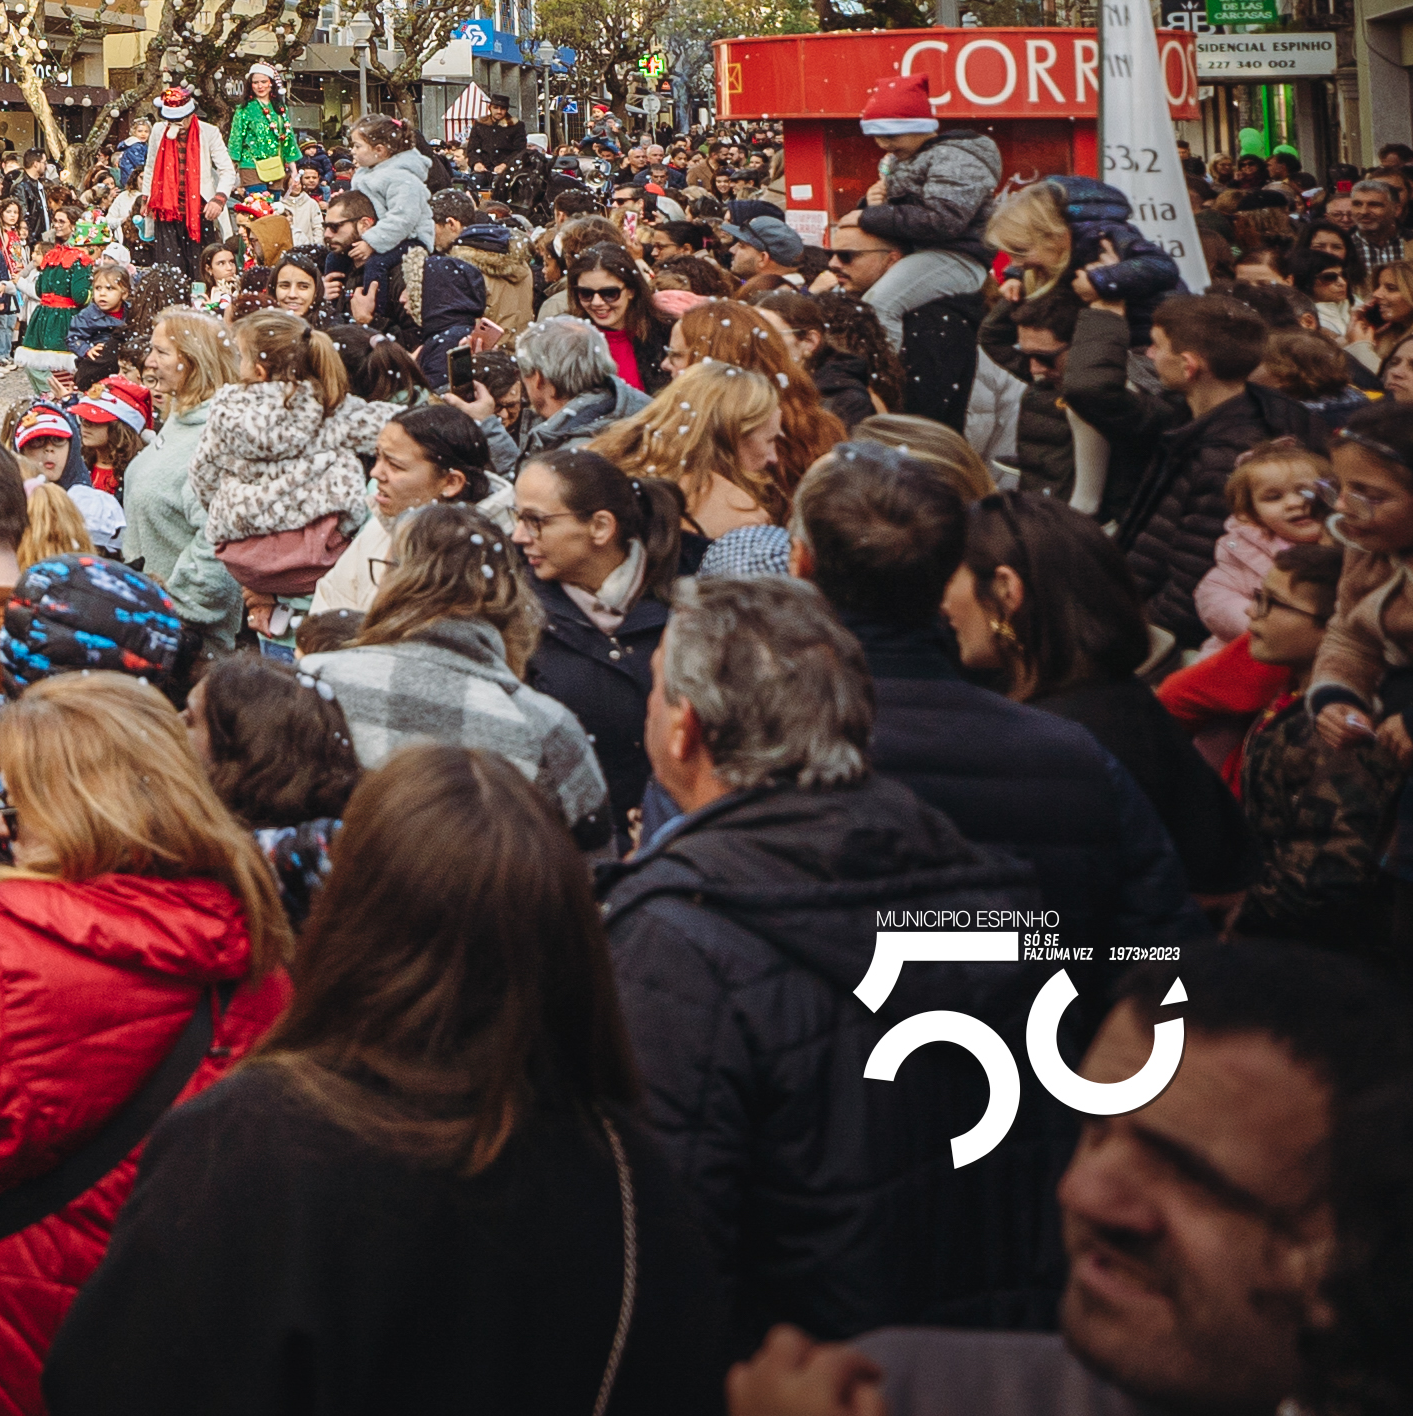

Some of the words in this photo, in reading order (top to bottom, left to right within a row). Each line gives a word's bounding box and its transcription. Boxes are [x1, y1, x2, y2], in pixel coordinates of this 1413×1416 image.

[1223, 3, 1239, 11] DE
[1241, 2, 1265, 10] LAS
[1214, 11, 1273, 20] CARCASAS
[1197, 42, 1266, 53] SIDENCIAL
[1272, 40, 1333, 52] ESPINHO
[1208, 61, 1231, 70] 227
[1236, 60, 1263, 69] 340
[1268, 59, 1297, 69] 002
[901, 38, 1197, 106] CORROS
[1133, 198, 1177, 221] ria
